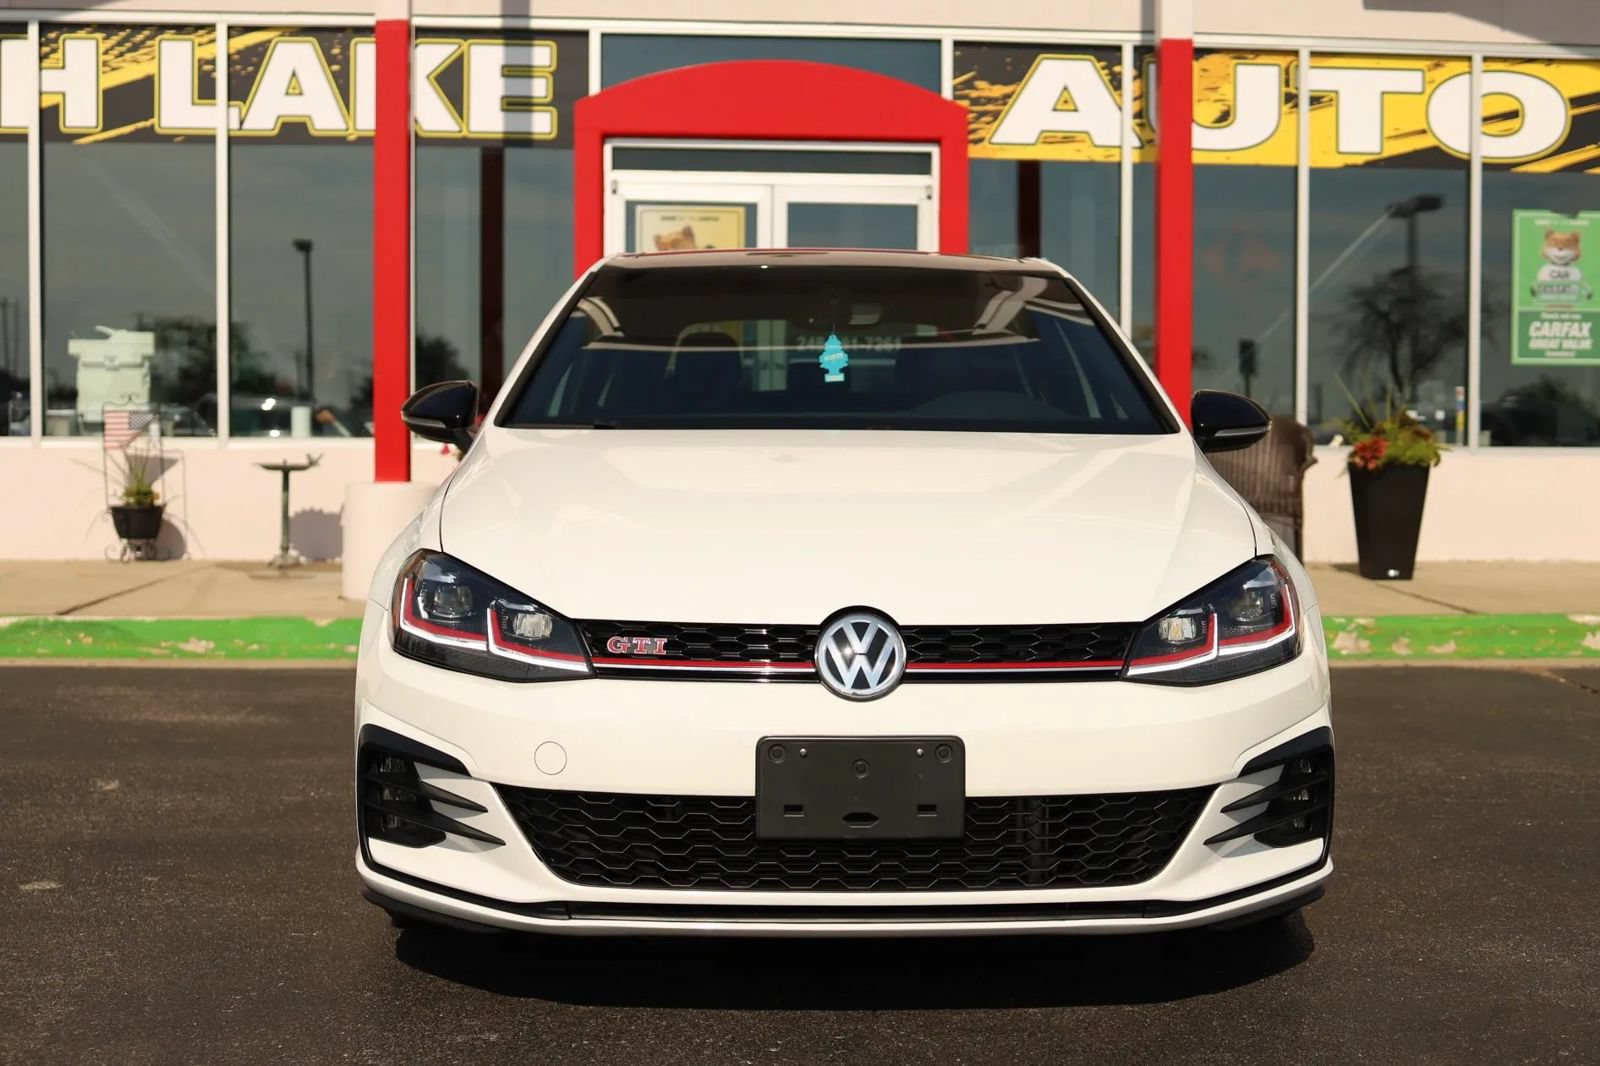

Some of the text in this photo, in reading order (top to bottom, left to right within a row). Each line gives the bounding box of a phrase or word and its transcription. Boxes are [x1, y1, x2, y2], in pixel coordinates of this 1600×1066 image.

[154, 35, 558, 140] LAKE
[988, 53, 1571, 164] AUTO
[1528, 321, 1593, 337] CARFAX
[607, 636, 668, 655] GTI
